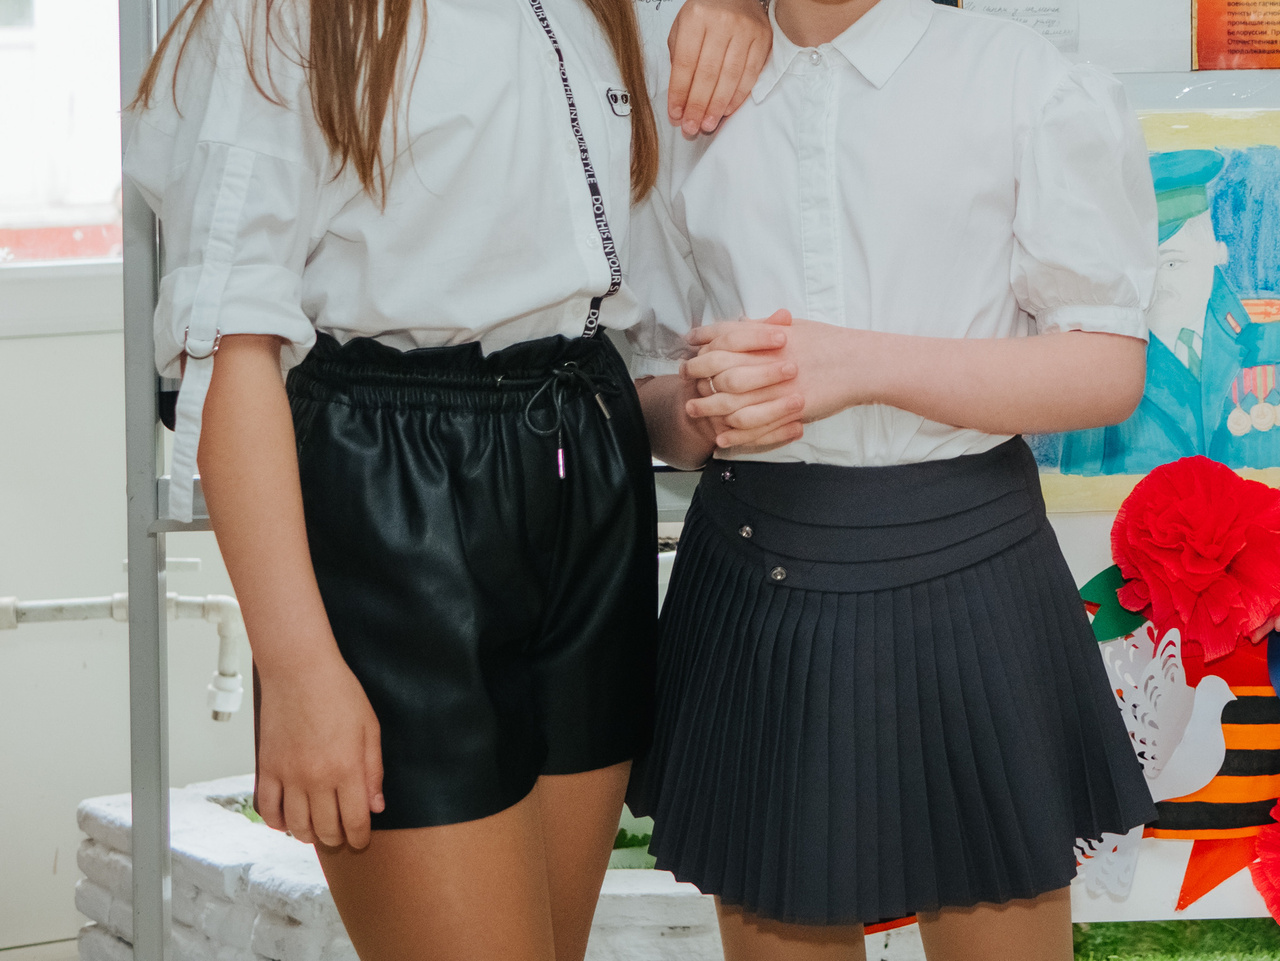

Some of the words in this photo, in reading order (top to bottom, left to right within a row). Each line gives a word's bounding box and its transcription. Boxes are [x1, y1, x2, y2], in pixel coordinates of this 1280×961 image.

[592, 195, 604, 214] DO
[595, 215, 611, 239] THIS
[603, 241, 614, 252] IN
[606, 253, 622, 283] YOUR
[586, 309, 599, 328] DO
